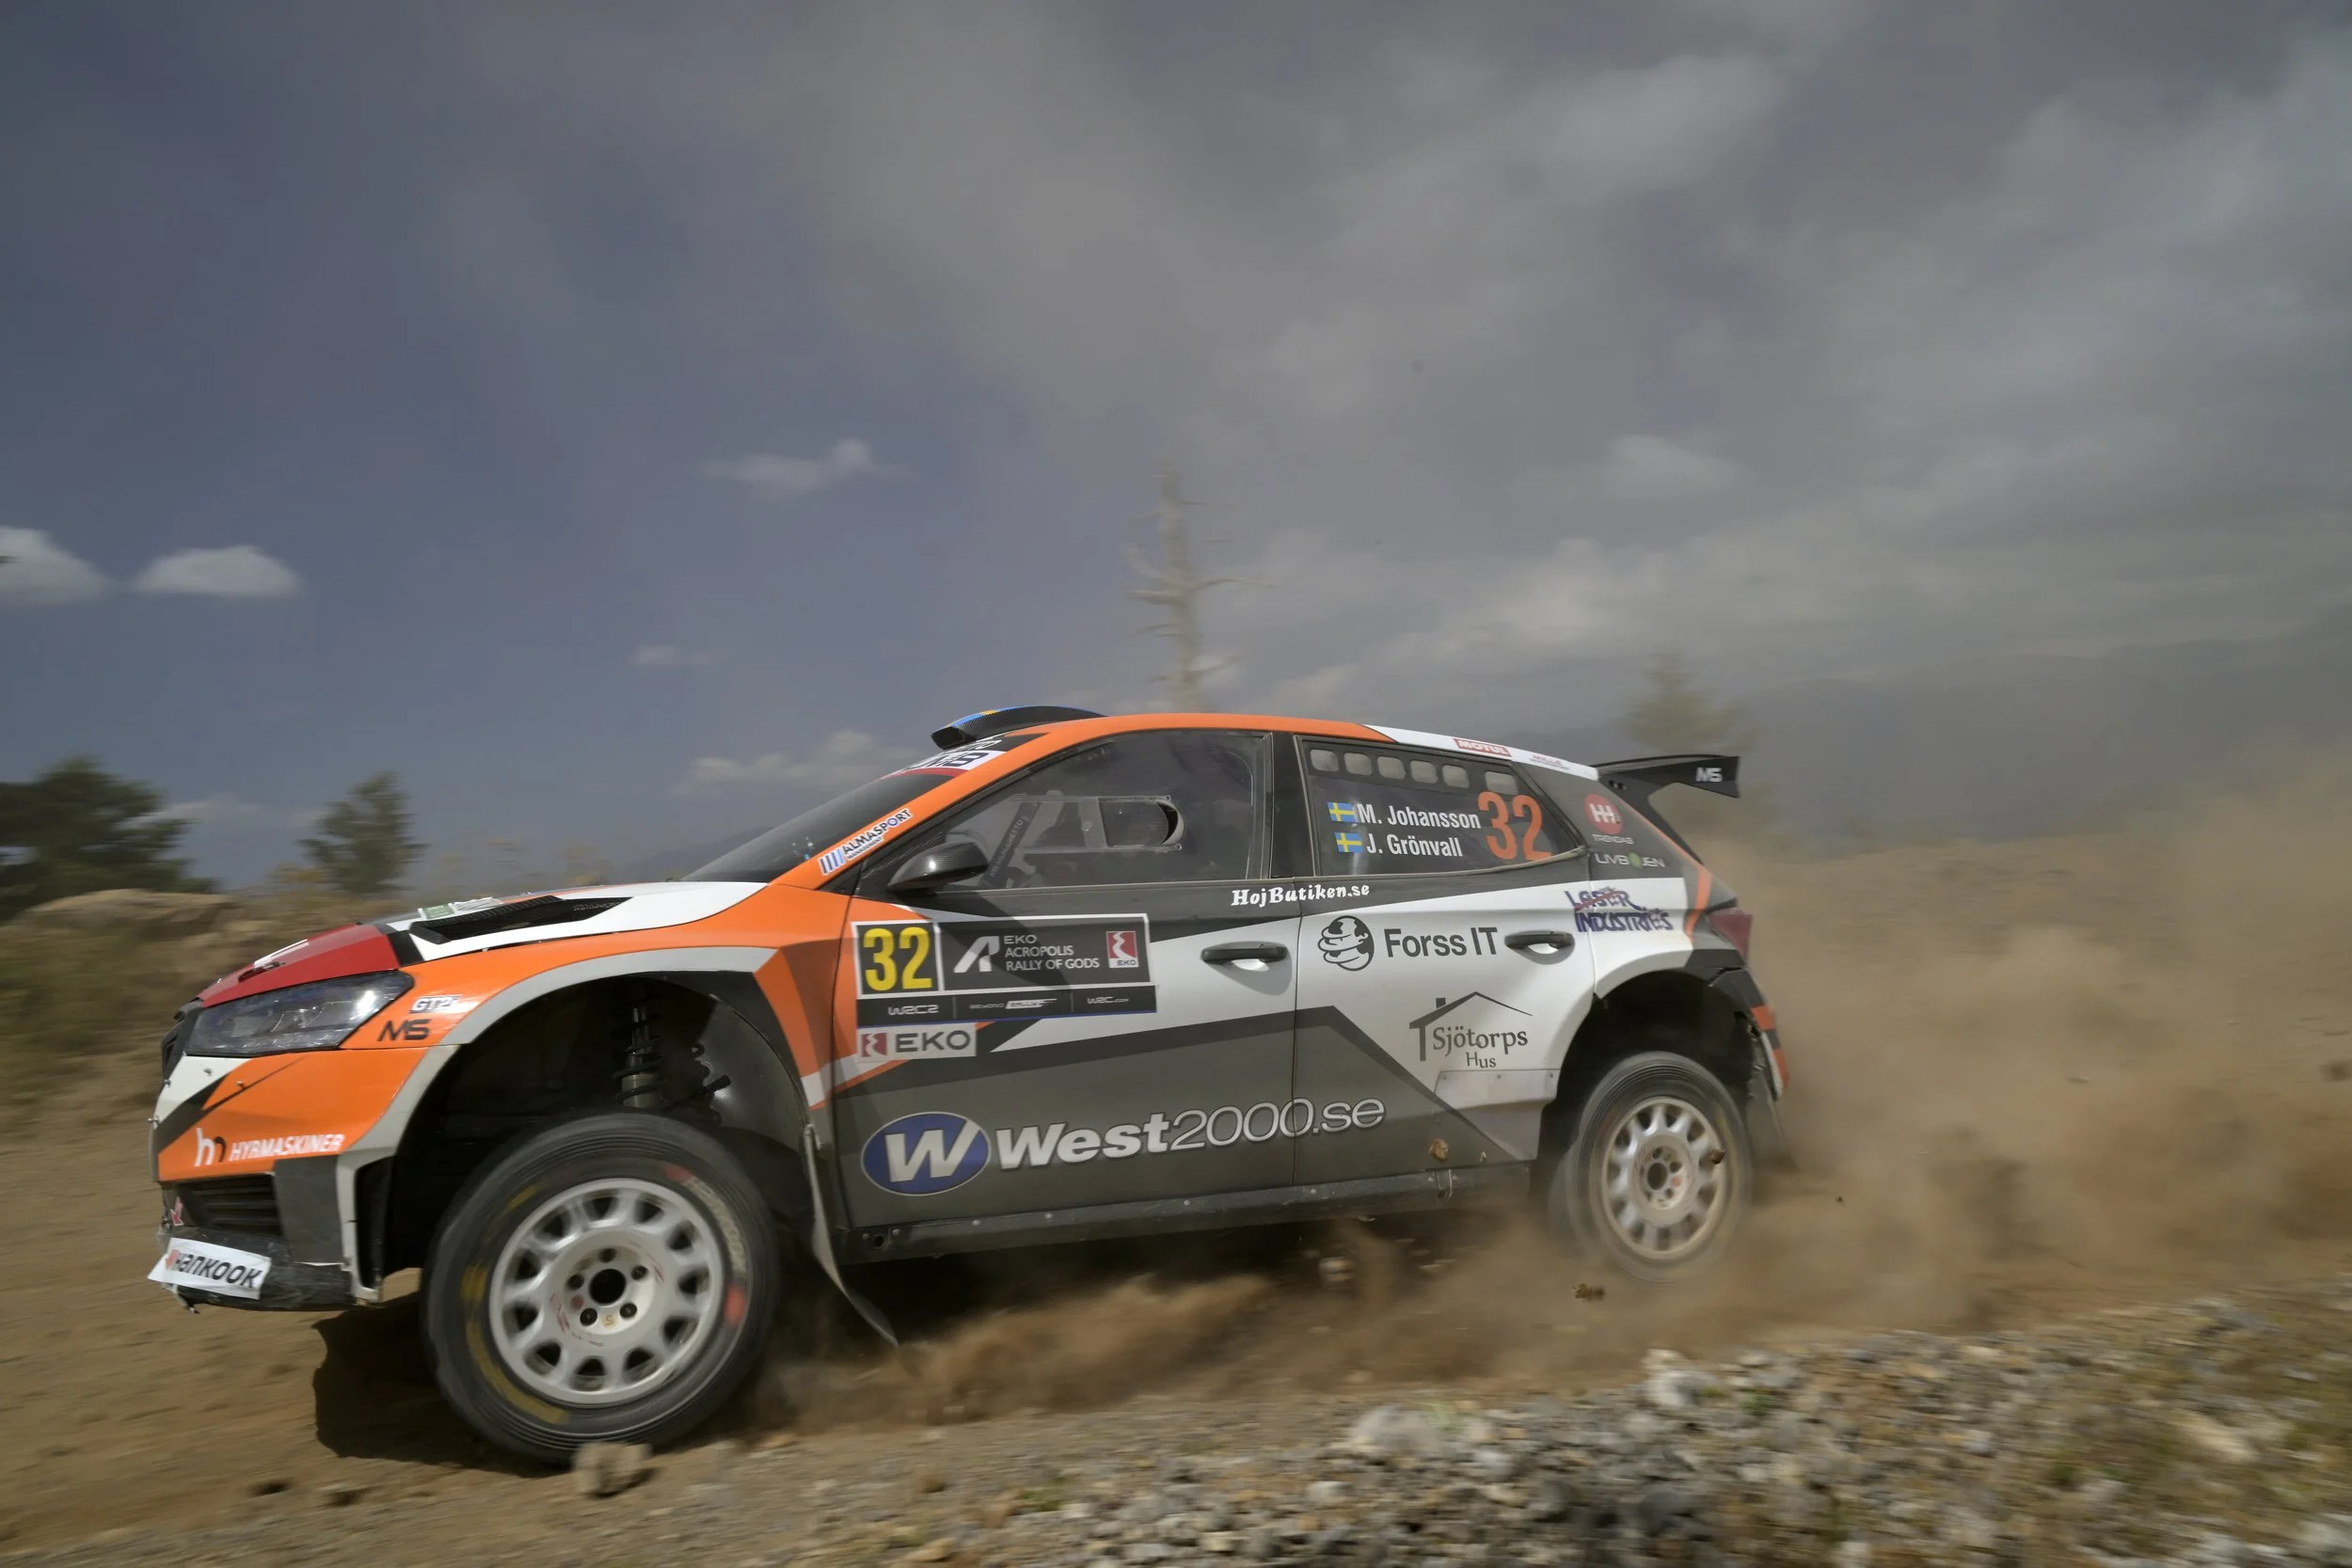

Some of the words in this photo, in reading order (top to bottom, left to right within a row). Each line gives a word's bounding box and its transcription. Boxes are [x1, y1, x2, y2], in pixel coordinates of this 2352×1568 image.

[1356, 803, 1383, 824] M.
[1388, 805, 1482, 829] Johansson
[1477, 791, 1551, 861] 32
[842, 808, 913, 855] ALMASPORT
[1366, 839, 1383, 854] J.
[1387, 832, 1464, 857] Grönvall
[1231, 884, 1370, 908] HojButiken.se
[1575, 909, 1674, 933] INDUSTRIES
[1004, 934, 1037, 945] EKO
[1005, 944, 1074, 958] ACROPOLIS
[1384, 928, 1467, 958] Forss
[1470, 927, 1498, 956] IT
[863, 927, 933, 991] 32
[1006, 959, 1042, 972] RALLY
[1045, 958, 1063, 970] OF
[1064, 958, 1101, 969] GODS
[888, 1004, 940, 1015] WRC2
[896, 1030, 971, 1053] EKO
[1433, 1026, 1528, 1057] Sjötorps
[1466, 1052, 1497, 1069] Hus
[997, 1098, 1386, 1170] West2000.se
